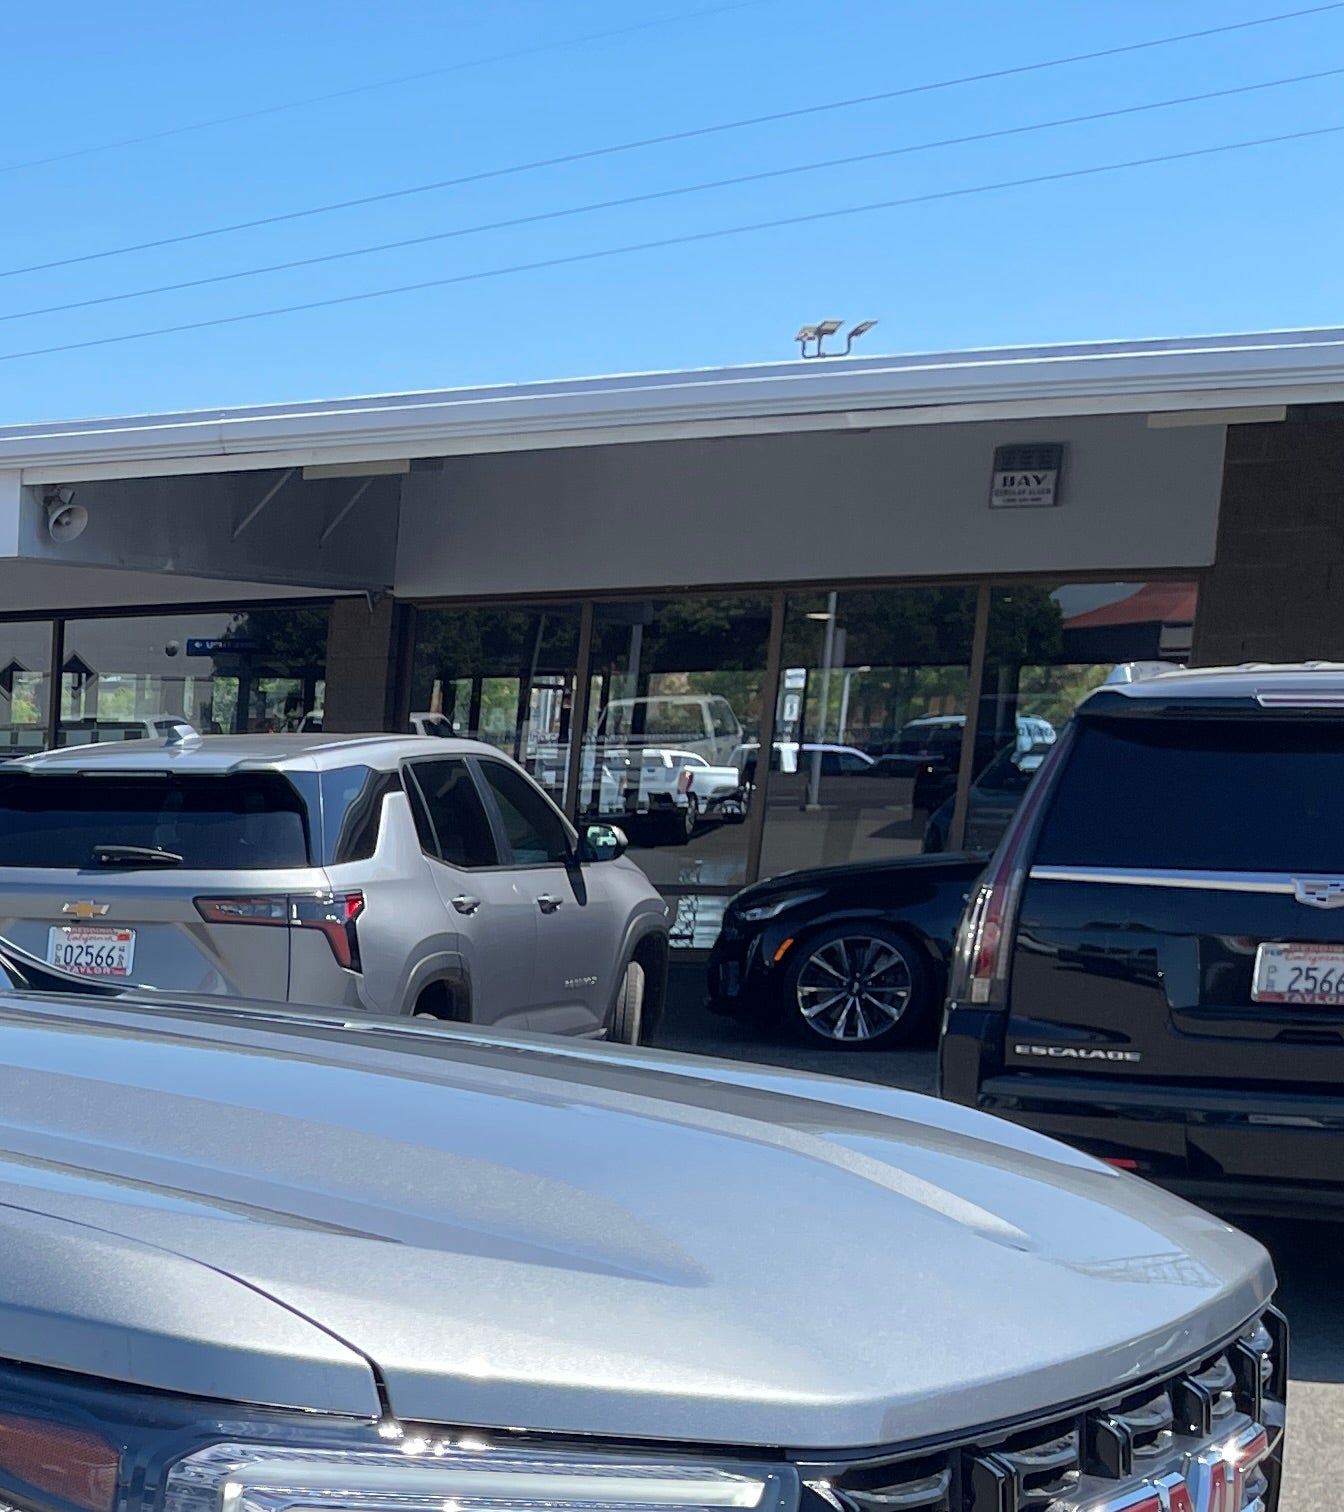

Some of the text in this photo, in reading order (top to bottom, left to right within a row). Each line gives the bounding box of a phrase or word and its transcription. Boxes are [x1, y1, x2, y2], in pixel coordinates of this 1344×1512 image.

[1002, 474, 1048, 488] BAY
[64, 944, 117, 967] 02566
[1015, 1044, 1141, 1062] ESCALADE
